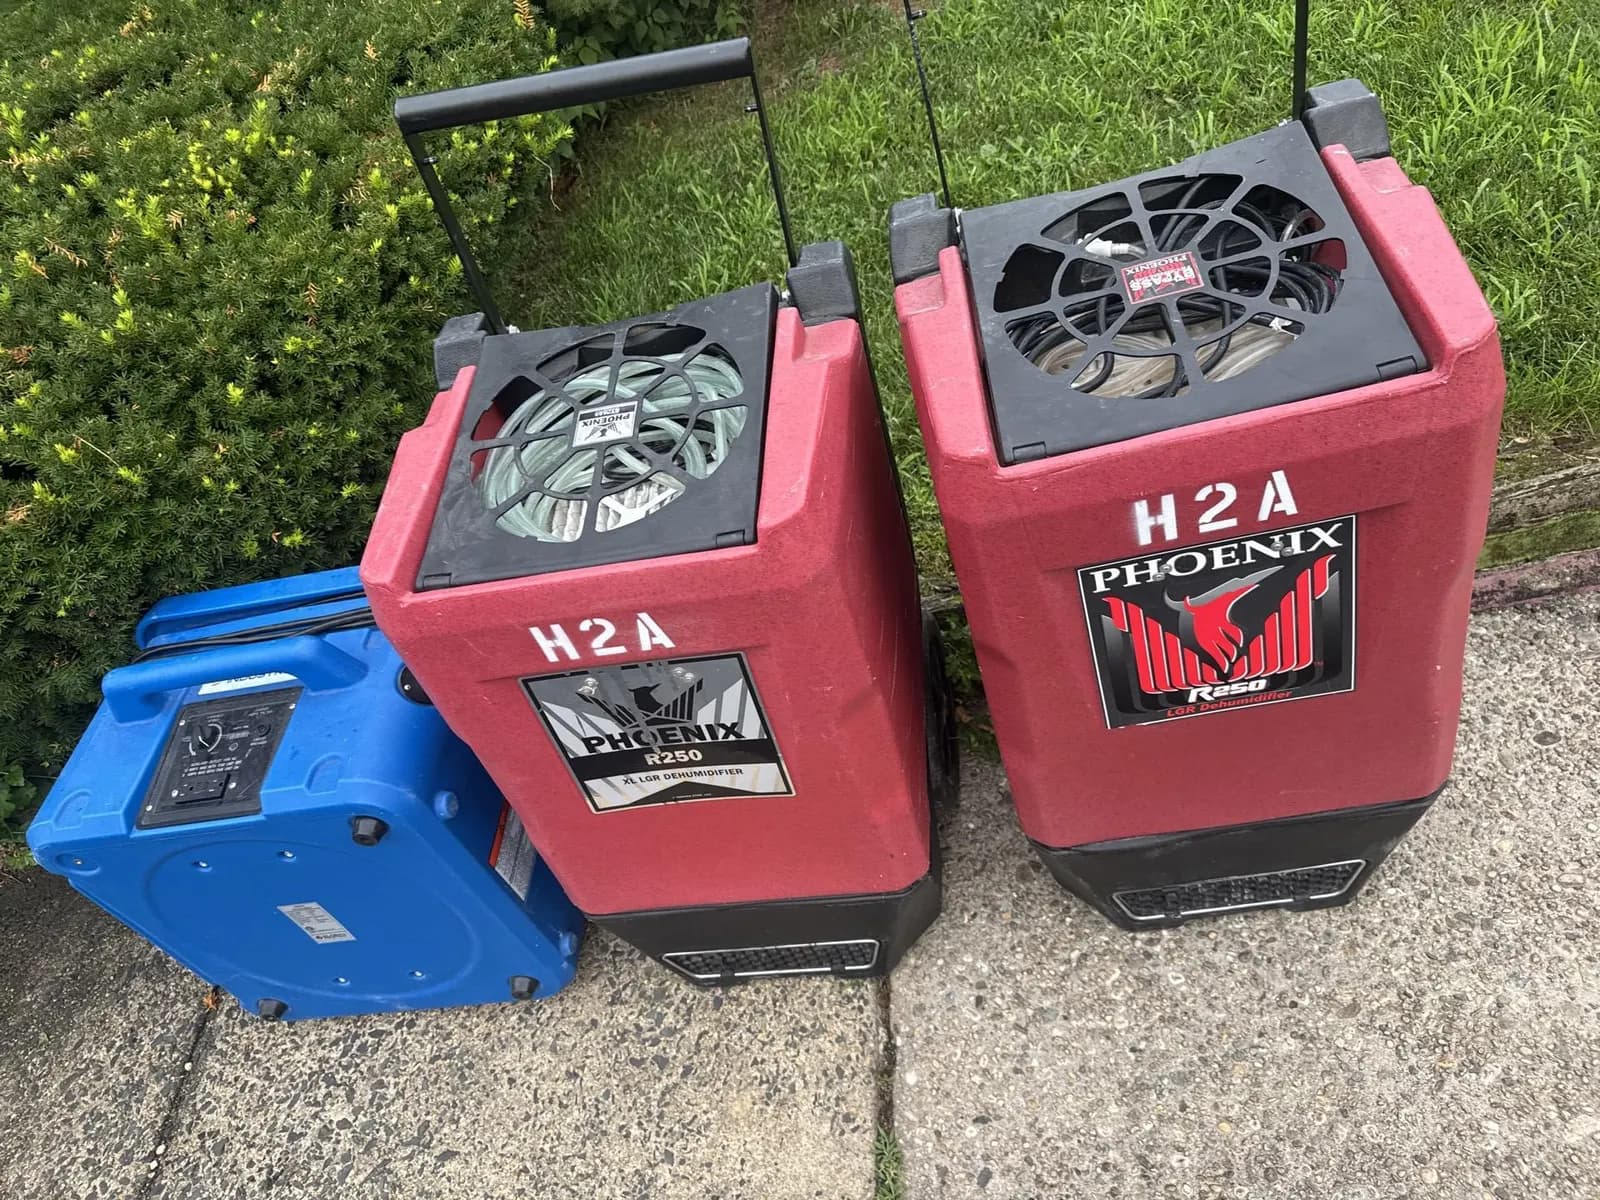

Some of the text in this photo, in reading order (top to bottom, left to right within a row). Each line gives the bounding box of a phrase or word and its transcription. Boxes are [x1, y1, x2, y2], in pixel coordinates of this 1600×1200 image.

[1126, 255, 1187, 275] PHOENIX
[1129, 265, 1195, 291] BYPASS
[582, 413, 630, 427] PHOENIX
[1089, 523, 1343, 593] PHOENIX
[1188, 679, 1268, 703] R250
[1166, 690, 1293, 718] LGR Dehumidifier
[582, 722, 746, 753] PHOENIX
[644, 750, 703, 766] R250
[622, 768, 745, 786] XL LGR DEHUMIDIFIER
